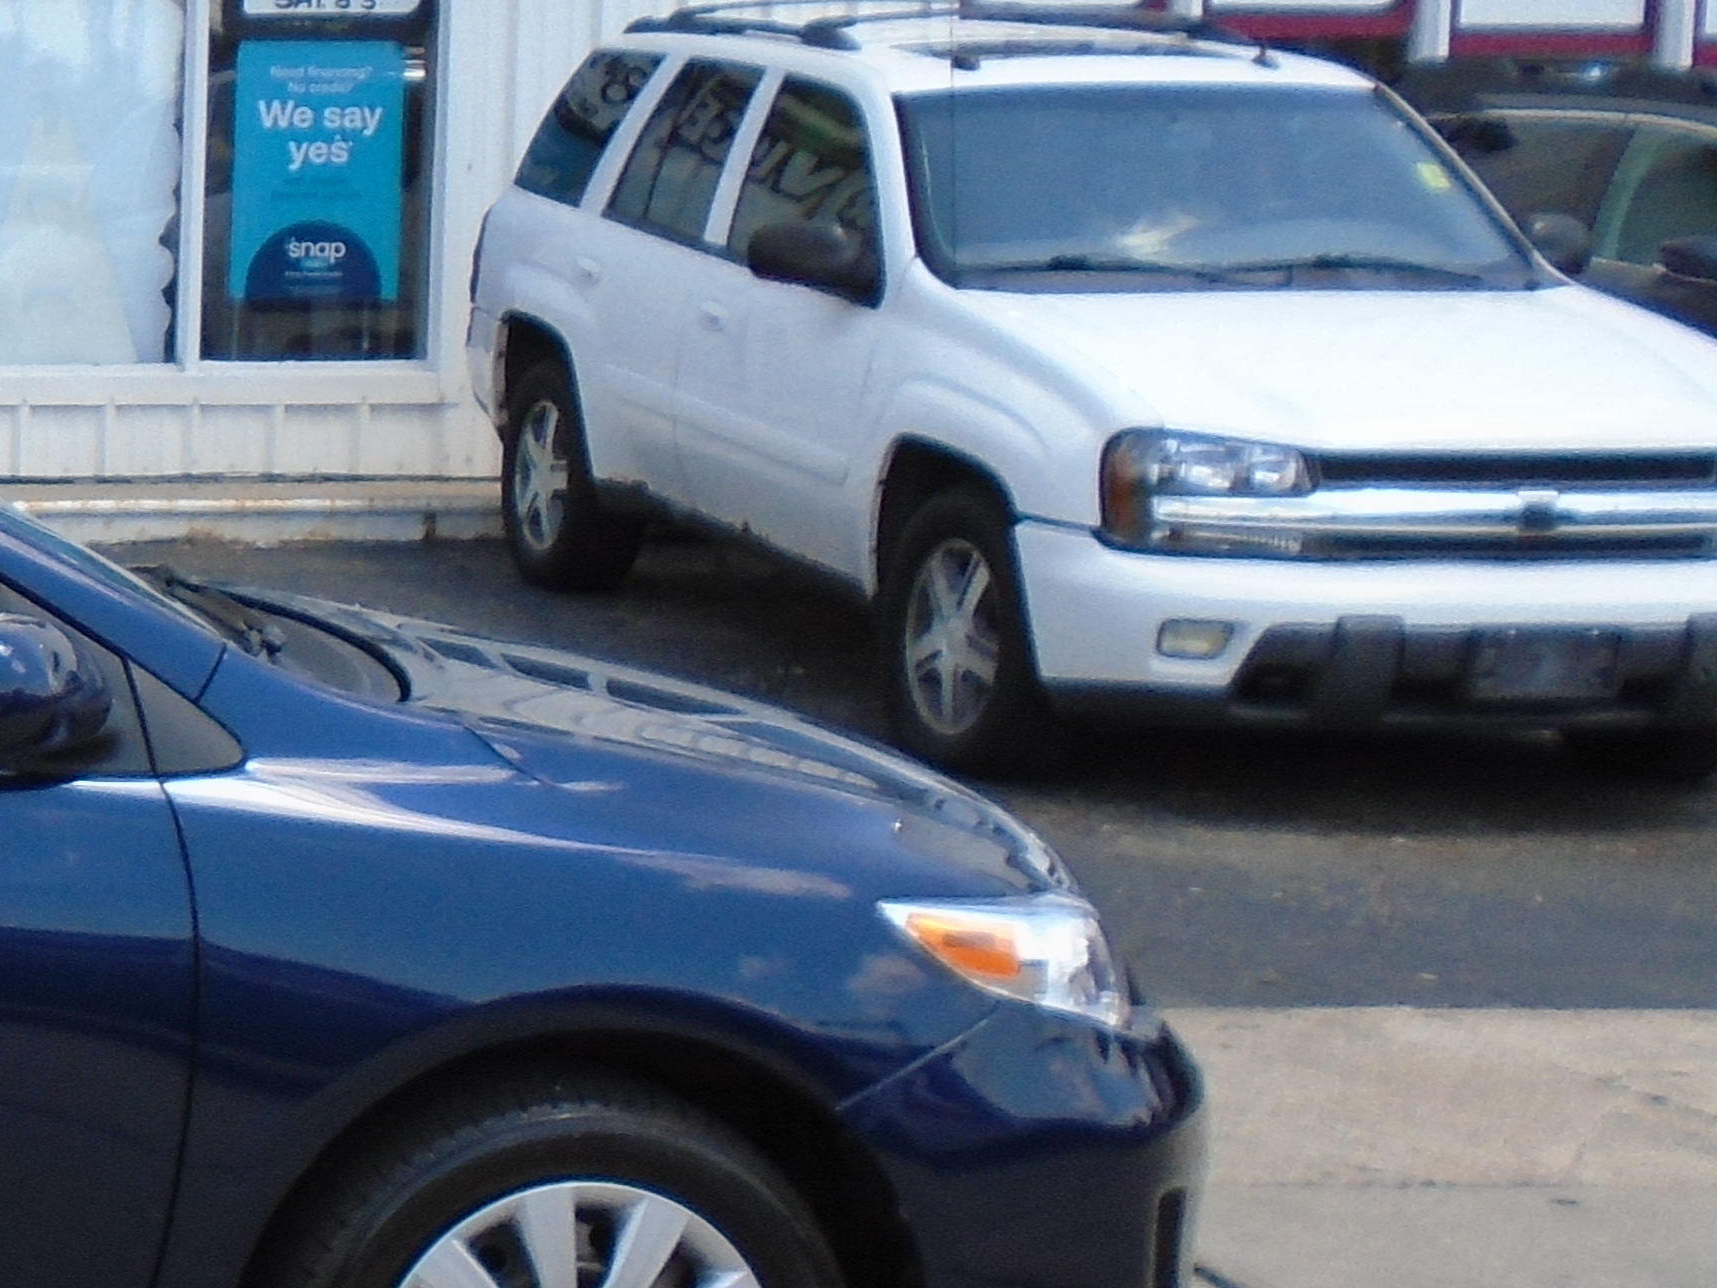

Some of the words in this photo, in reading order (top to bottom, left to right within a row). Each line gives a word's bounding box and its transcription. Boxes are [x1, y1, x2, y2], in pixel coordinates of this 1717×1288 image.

[258, 99, 314, 129] We
[323, 106, 383, 137] say
[288, 240, 347, 265] snap
